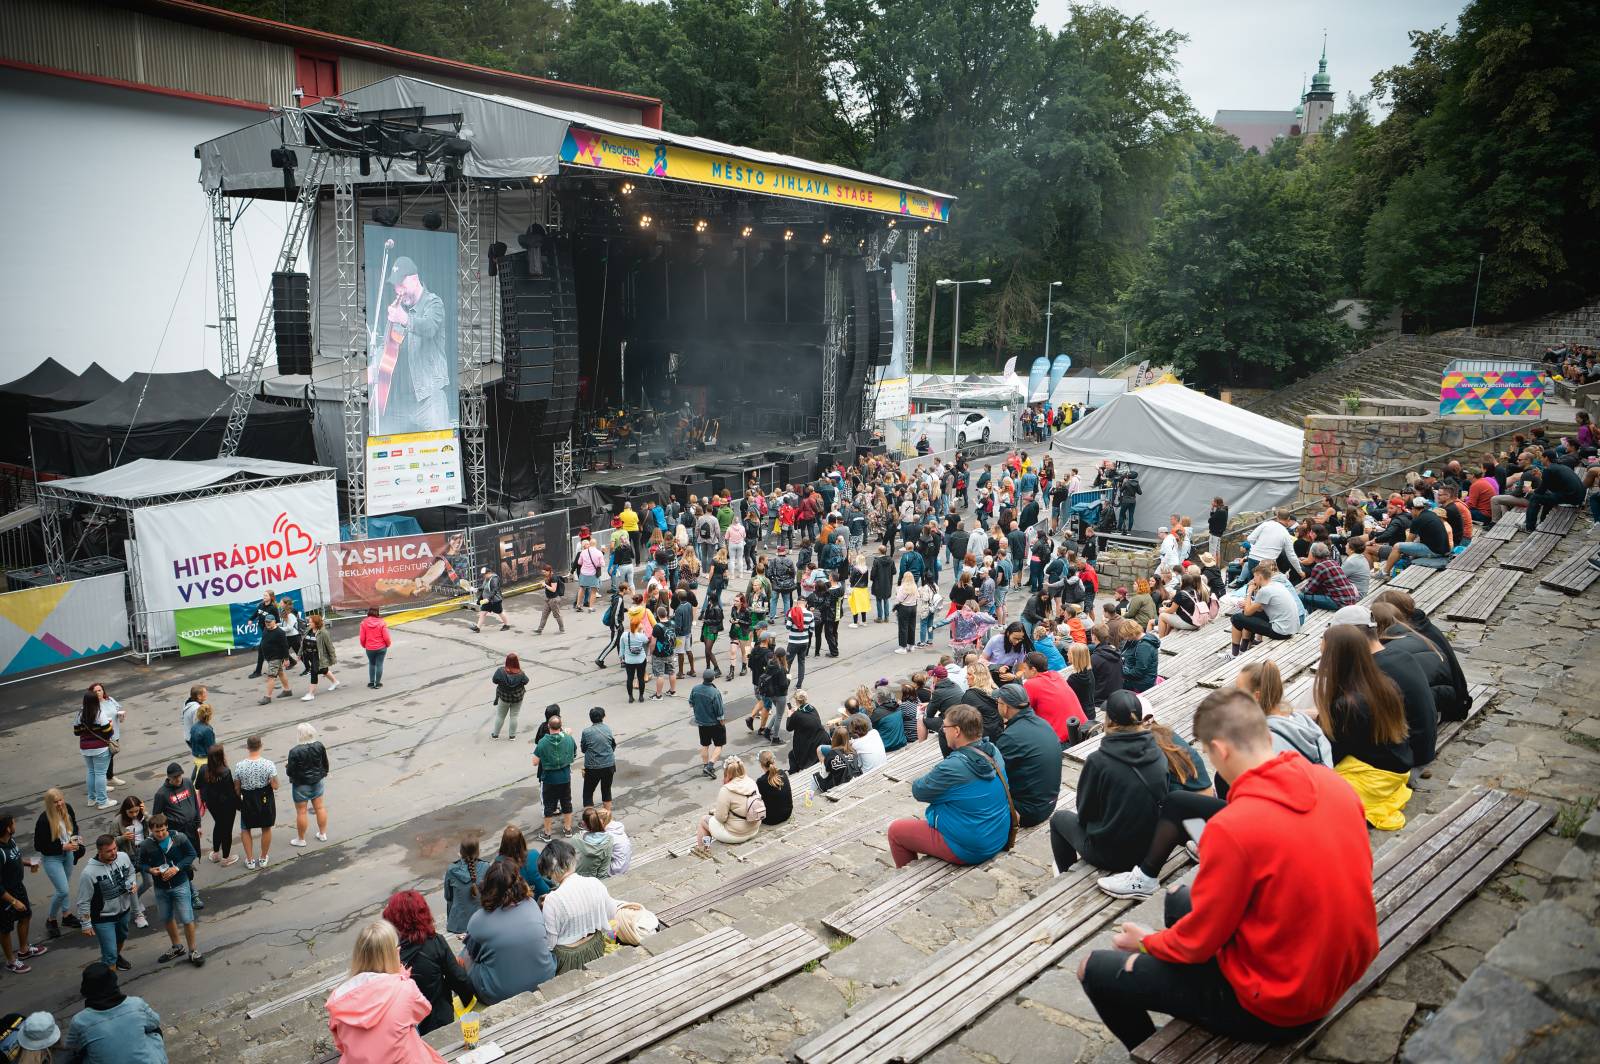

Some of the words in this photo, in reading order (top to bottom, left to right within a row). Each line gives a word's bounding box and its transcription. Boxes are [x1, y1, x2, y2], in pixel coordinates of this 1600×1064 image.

[602, 141, 640, 158] VYSOČINA
[622, 157, 640, 167] FEST
[712, 161, 765, 185] MĚSTO
[773, 174, 829, 195] JIHLAVA
[836, 184, 873, 203] STAGE
[173, 540, 284, 579] HITRÁDIO
[332, 542, 433, 566] YASHICA
[338, 565, 385, 577] REKLAMNÍ
[387, 562, 433, 573] AGENTURA
[177, 562, 298, 603] VYSOČINA
